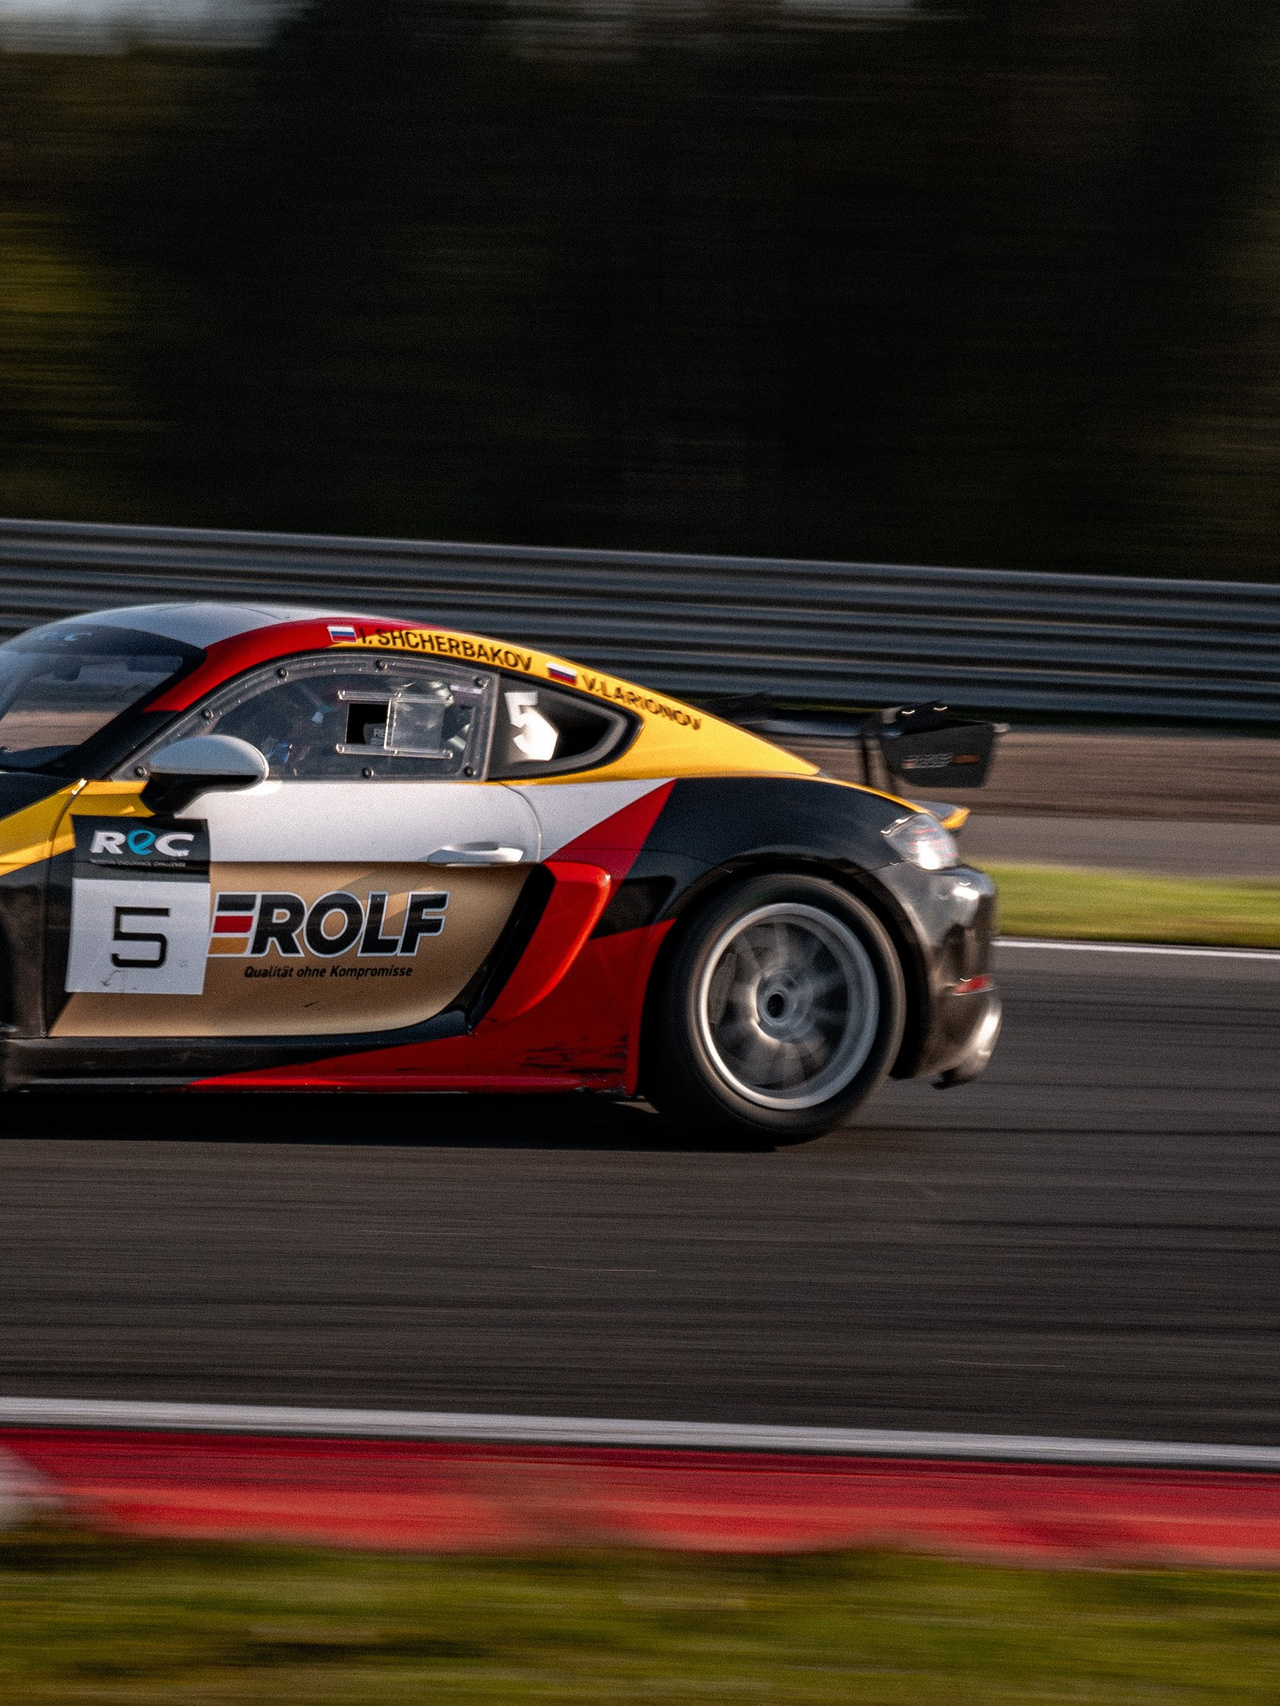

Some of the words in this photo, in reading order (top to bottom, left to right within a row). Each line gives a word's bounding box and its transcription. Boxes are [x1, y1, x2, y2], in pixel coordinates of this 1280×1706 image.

[358, 628, 372, 645] I.
[375, 628, 532, 672] SHCHERBAKOV
[504, 690, 559, 761] 5
[110, 906, 170, 968] 5
[249, 891, 450, 957] ROLF
[244, 965, 293, 978] Qualität
[296, 966, 327, 978] ohne
[329, 965, 413, 979] Kompromisse
